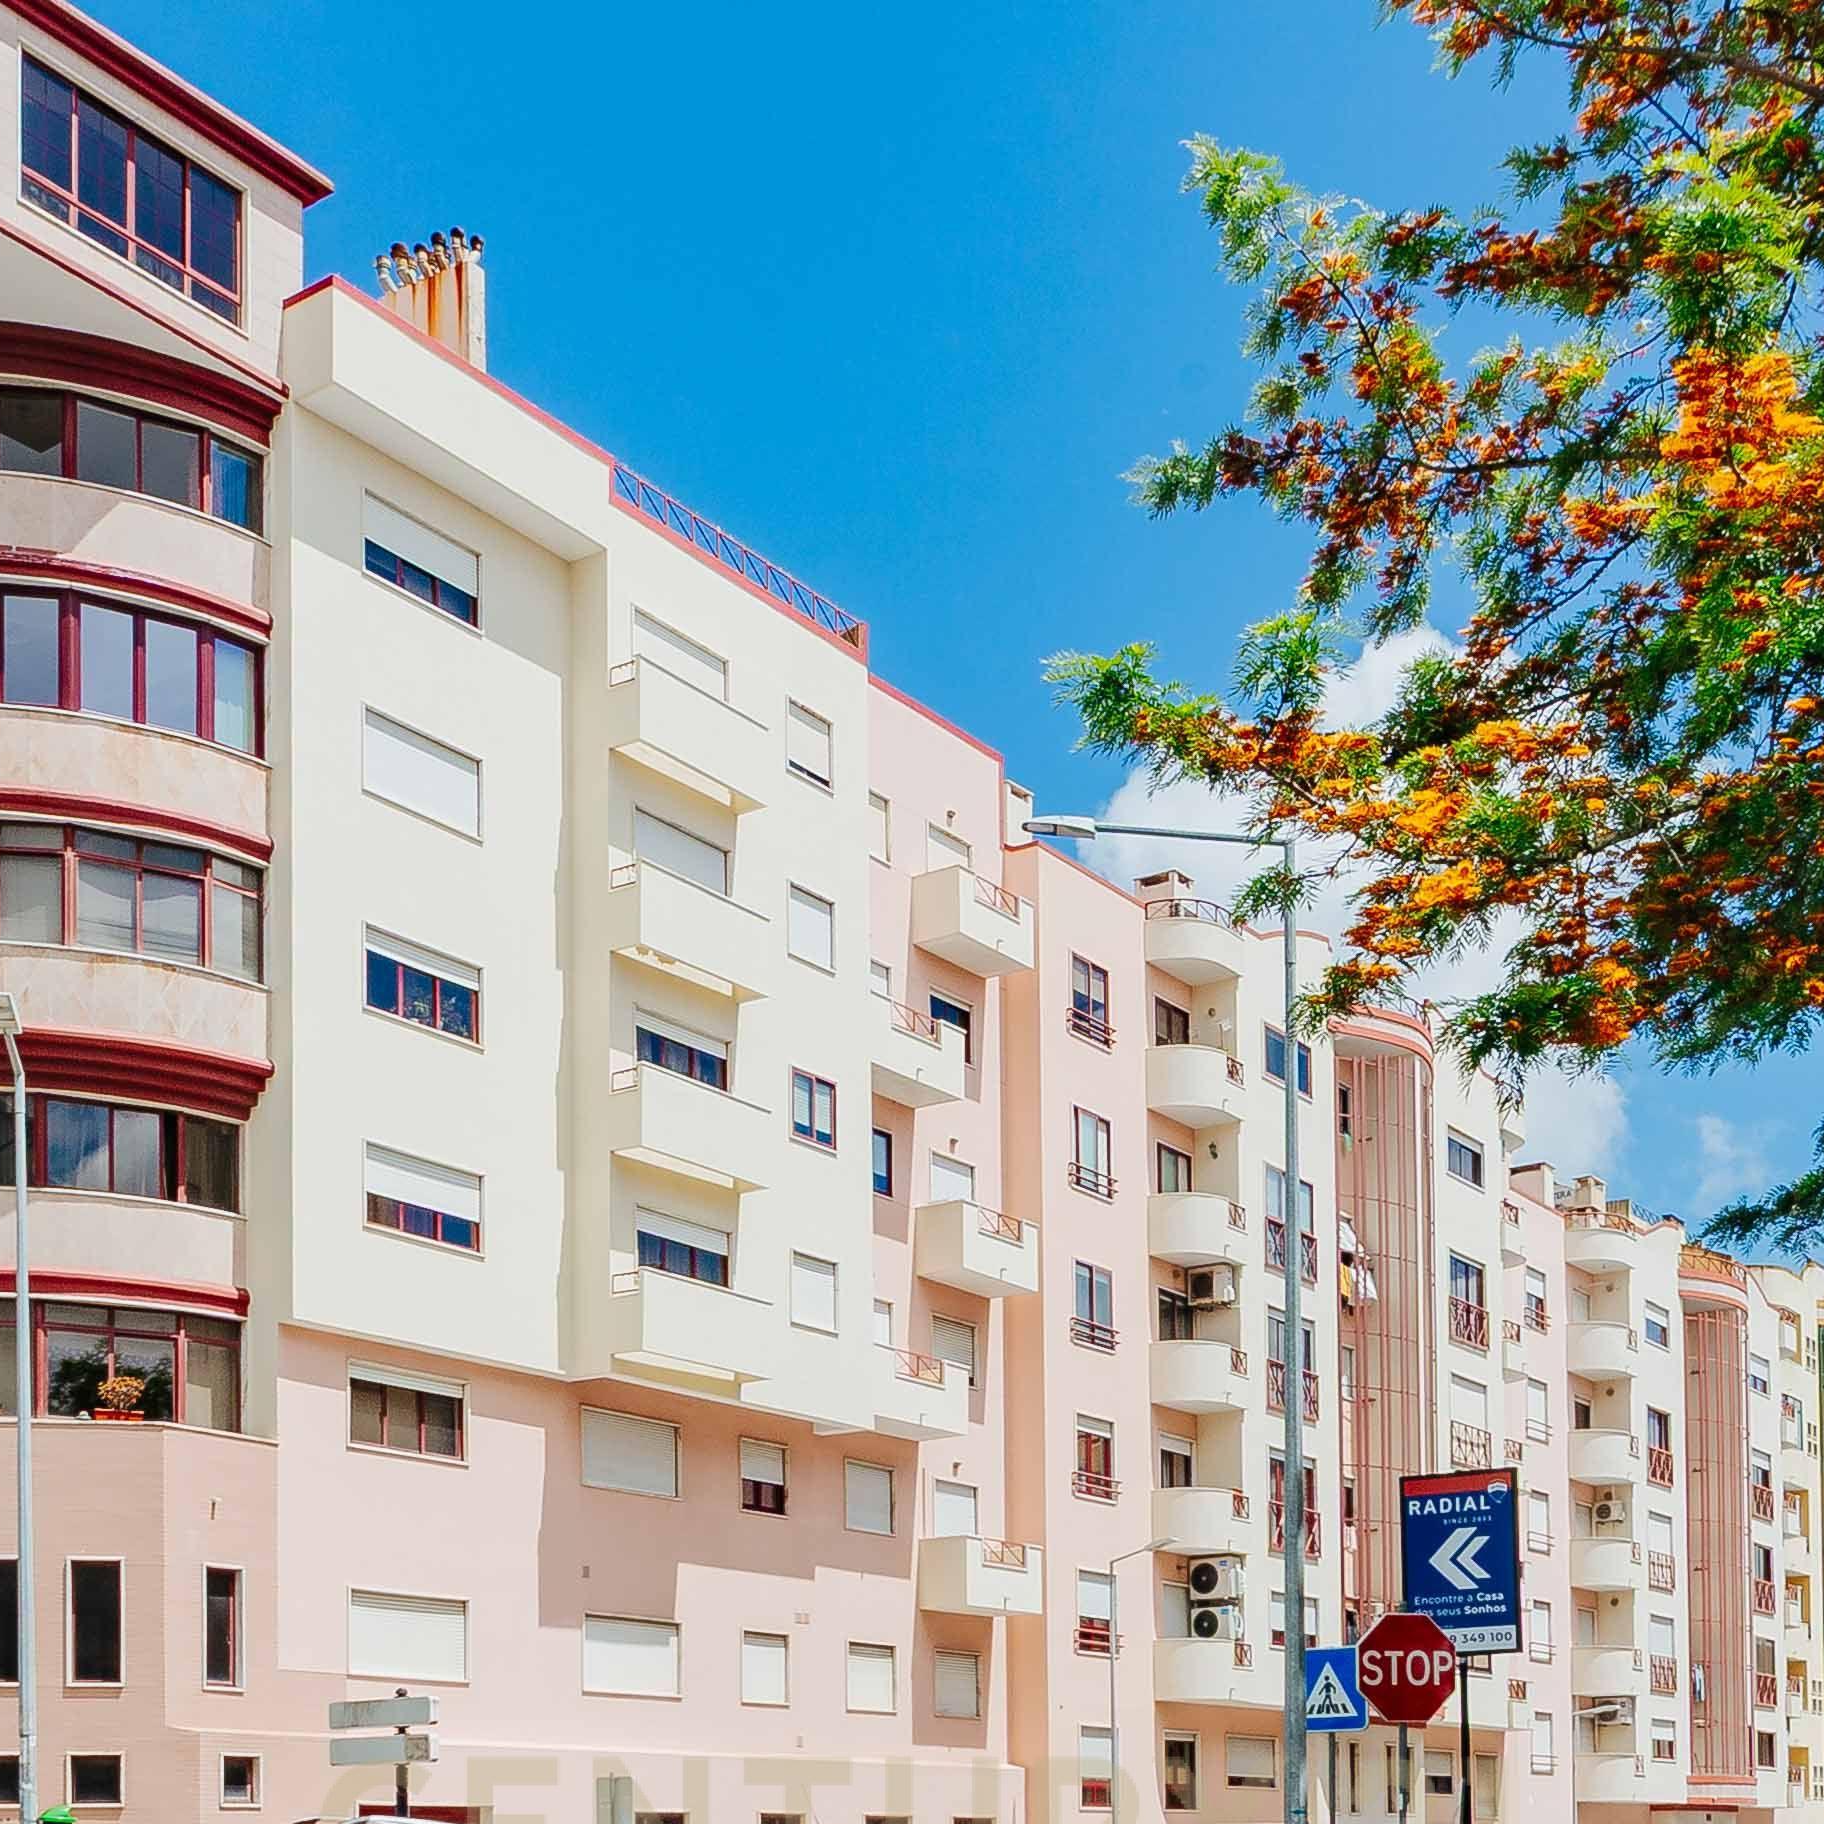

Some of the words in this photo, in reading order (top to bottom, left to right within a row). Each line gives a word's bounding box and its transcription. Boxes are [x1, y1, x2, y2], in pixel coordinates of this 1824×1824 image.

[1408, 1494, 1491, 1516] RADIAL
[1414, 1595, 1464, 1606] Encontre
[1466, 1594, 1474, 1603] a
[1476, 1591, 1505, 1602] Casa
[1436, 1607, 1462, 1617] seus
[1463, 1603, 1508, 1615] Sonhos
[1460, 1631, 1486, 1645] 349
[1489, 1630, 1513, 1642] 100
[1361, 1649, 1453, 1686] STOP
